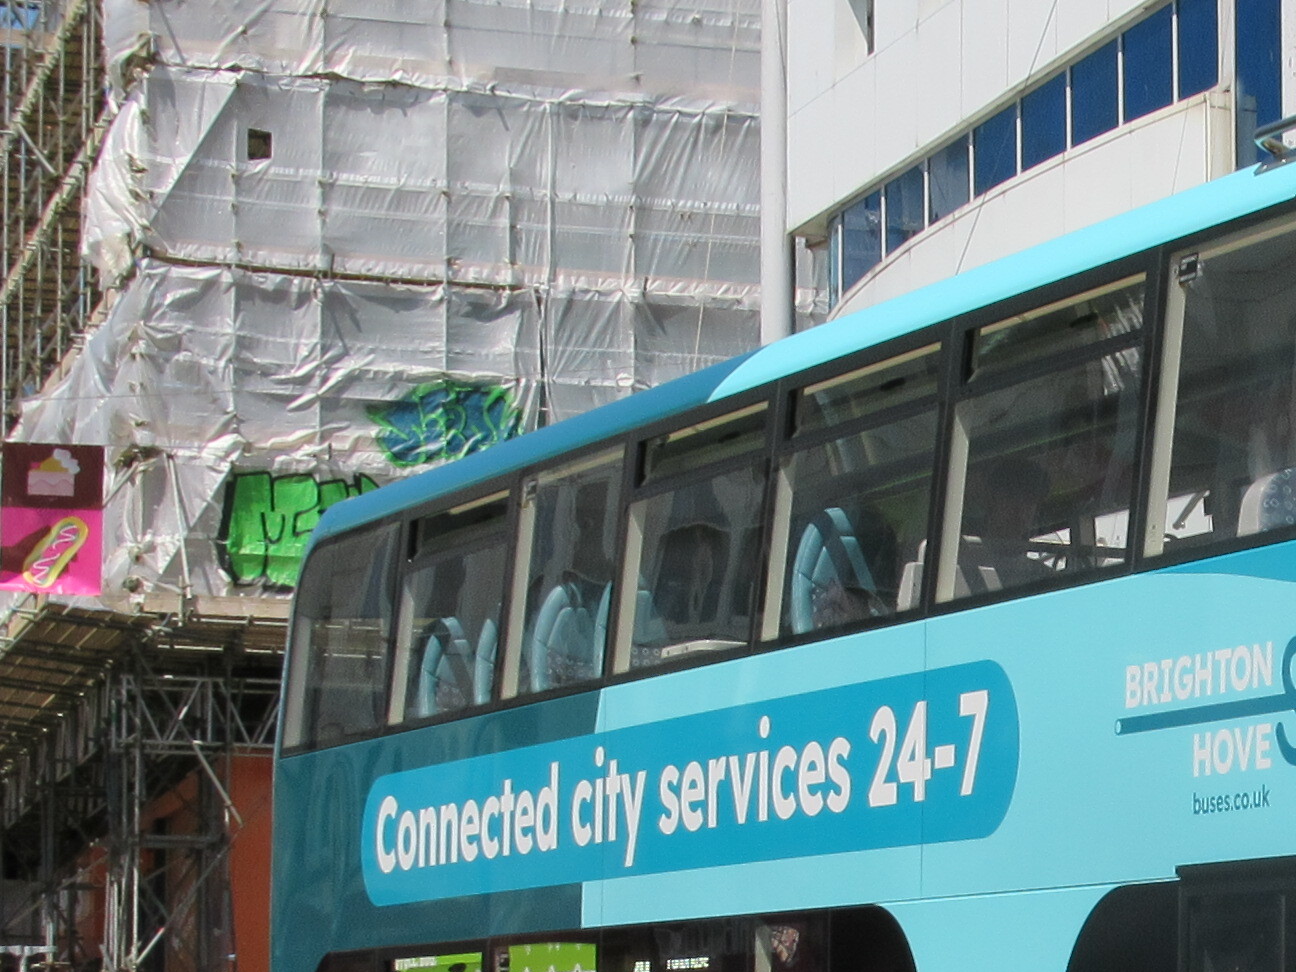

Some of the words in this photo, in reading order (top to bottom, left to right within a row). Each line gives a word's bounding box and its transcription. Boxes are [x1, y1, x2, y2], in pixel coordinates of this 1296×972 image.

[1125, 641, 1273, 709] BRIGHTON
[1192, 723, 1272, 777] HOVE
[375, 762, 559, 875] Connected
[571, 746, 647, 868] city
[659, 715, 851, 836] services
[868, 689, 990, 809] 24-7
[1192, 784, 1271, 815] buses.co.uk
